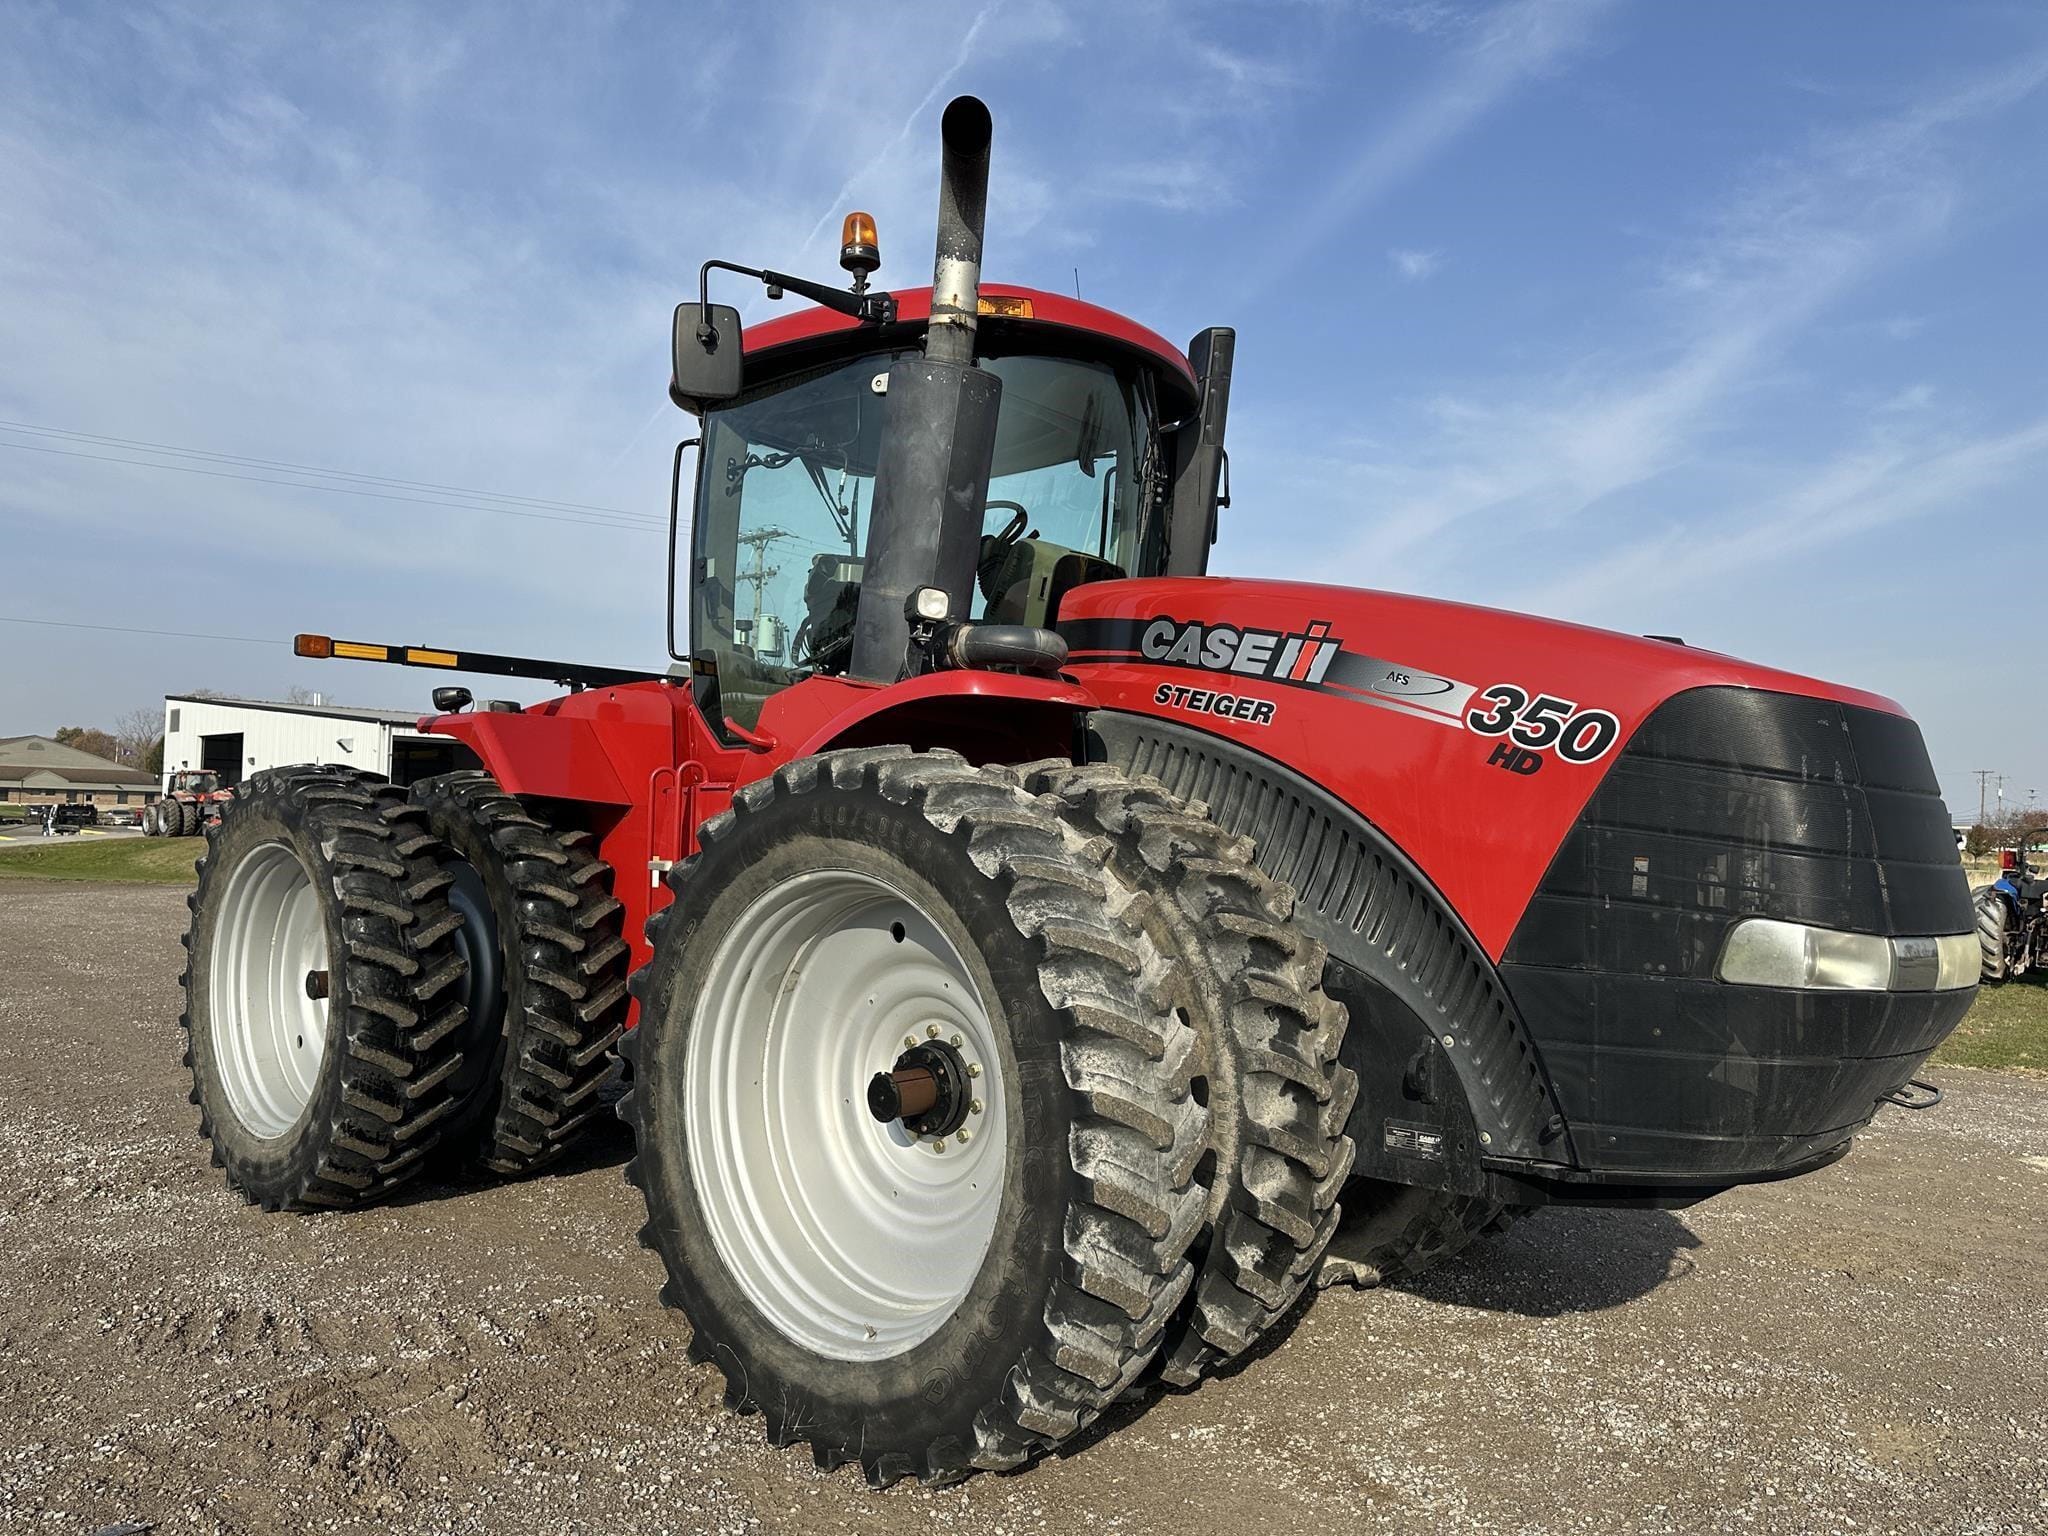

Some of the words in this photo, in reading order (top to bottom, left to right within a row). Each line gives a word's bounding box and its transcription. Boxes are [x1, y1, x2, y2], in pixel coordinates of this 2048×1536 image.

[1141, 620, 1279, 675] CASE
[1386, 671, 1410, 685] AFS
[1153, 682, 1277, 725] STEIGER
[1466, 683, 1621, 765] 350
[1486, 742, 1544, 776] HD
